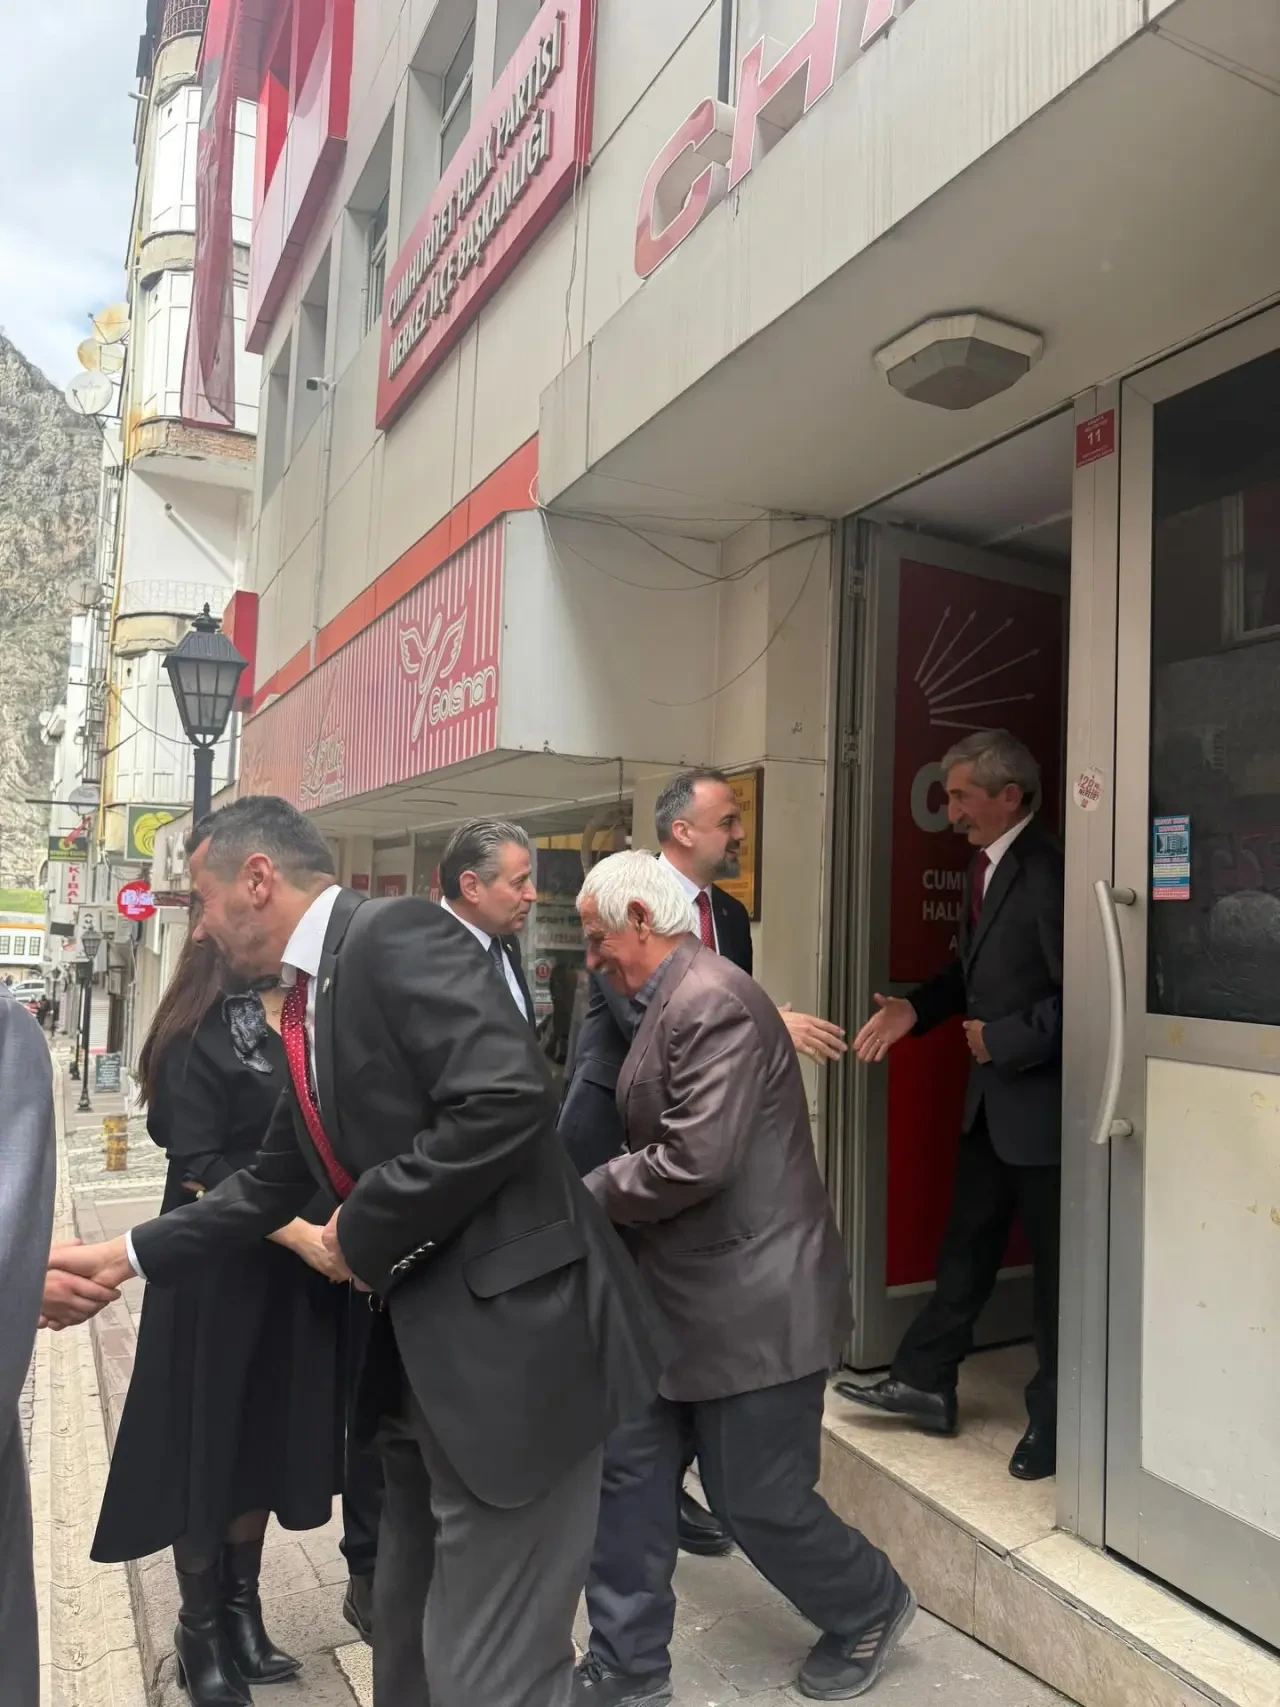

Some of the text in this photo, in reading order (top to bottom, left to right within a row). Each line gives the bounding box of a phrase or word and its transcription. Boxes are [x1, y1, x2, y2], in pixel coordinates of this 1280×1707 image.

[388, 10, 565, 328] CUMHURİYET HALK PARTİSİ
[388, 108, 552, 381] MERKEZ İLÇE BAŞKANLIĞI
[634, 0, 896, 279] CH
[1087, 427, 1101, 446] 11
